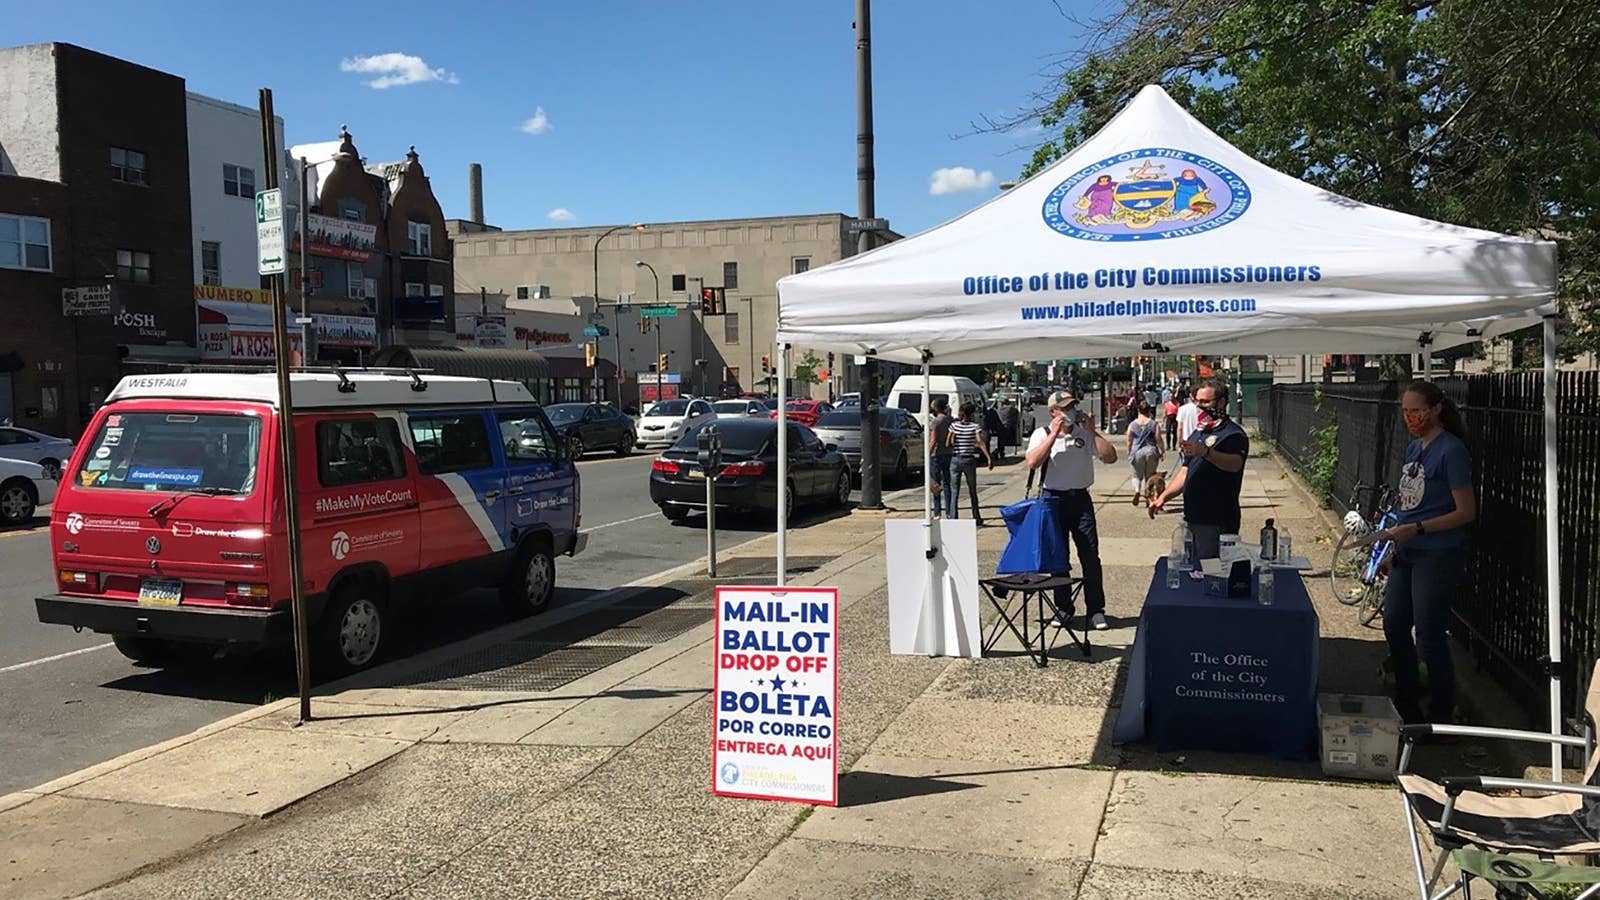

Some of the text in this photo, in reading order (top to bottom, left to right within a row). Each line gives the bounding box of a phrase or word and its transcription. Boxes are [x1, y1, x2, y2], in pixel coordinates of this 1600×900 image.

[1118, 151, 1139, 161] OF
[1157, 149, 1186, 159] THE
[1197, 159, 1229, 175] CITY
[1053, 164, 1106, 197] COUNCIL
[1229, 180, 1245, 191] OF
[258, 199, 264, 218] 2
[1051, 221, 1069, 231] OF
[1160, 198, 1247, 238] PHILADELPHIA
[1077, 231, 1112, 240] SEAL
[963, 264, 1321, 295] Office of the City Commissioners
[194, 287, 253, 302] NUMERO
[1021, 298, 1256, 320] www.philadelphiavotes.com
[114, 313, 155, 327] POSH
[211, 333, 228, 341] ROSA
[231, 336, 244, 356] LA
[247, 336, 275, 357] ROSA
[128, 378, 187, 387] WESTFALIA
[315, 489, 411, 512] #MakeMyVoteCount
[195, 527, 217, 536] Draw
[724, 601, 829, 624] MAIL-IN
[723, 629, 830, 653] BALLOT
[721, 653, 828, 673] DROP OFF
[1190, 652, 1269, 667] The Office
[1191, 670, 1268, 687] of the City
[1175, 685, 1285, 703] Commissioners
[721, 690, 832, 718] BOLETA
[719, 719, 831, 739] POR CORREO
[718, 739, 832, 760] ENTREGA AQUÍ
[742, 779, 758, 788] CITY
